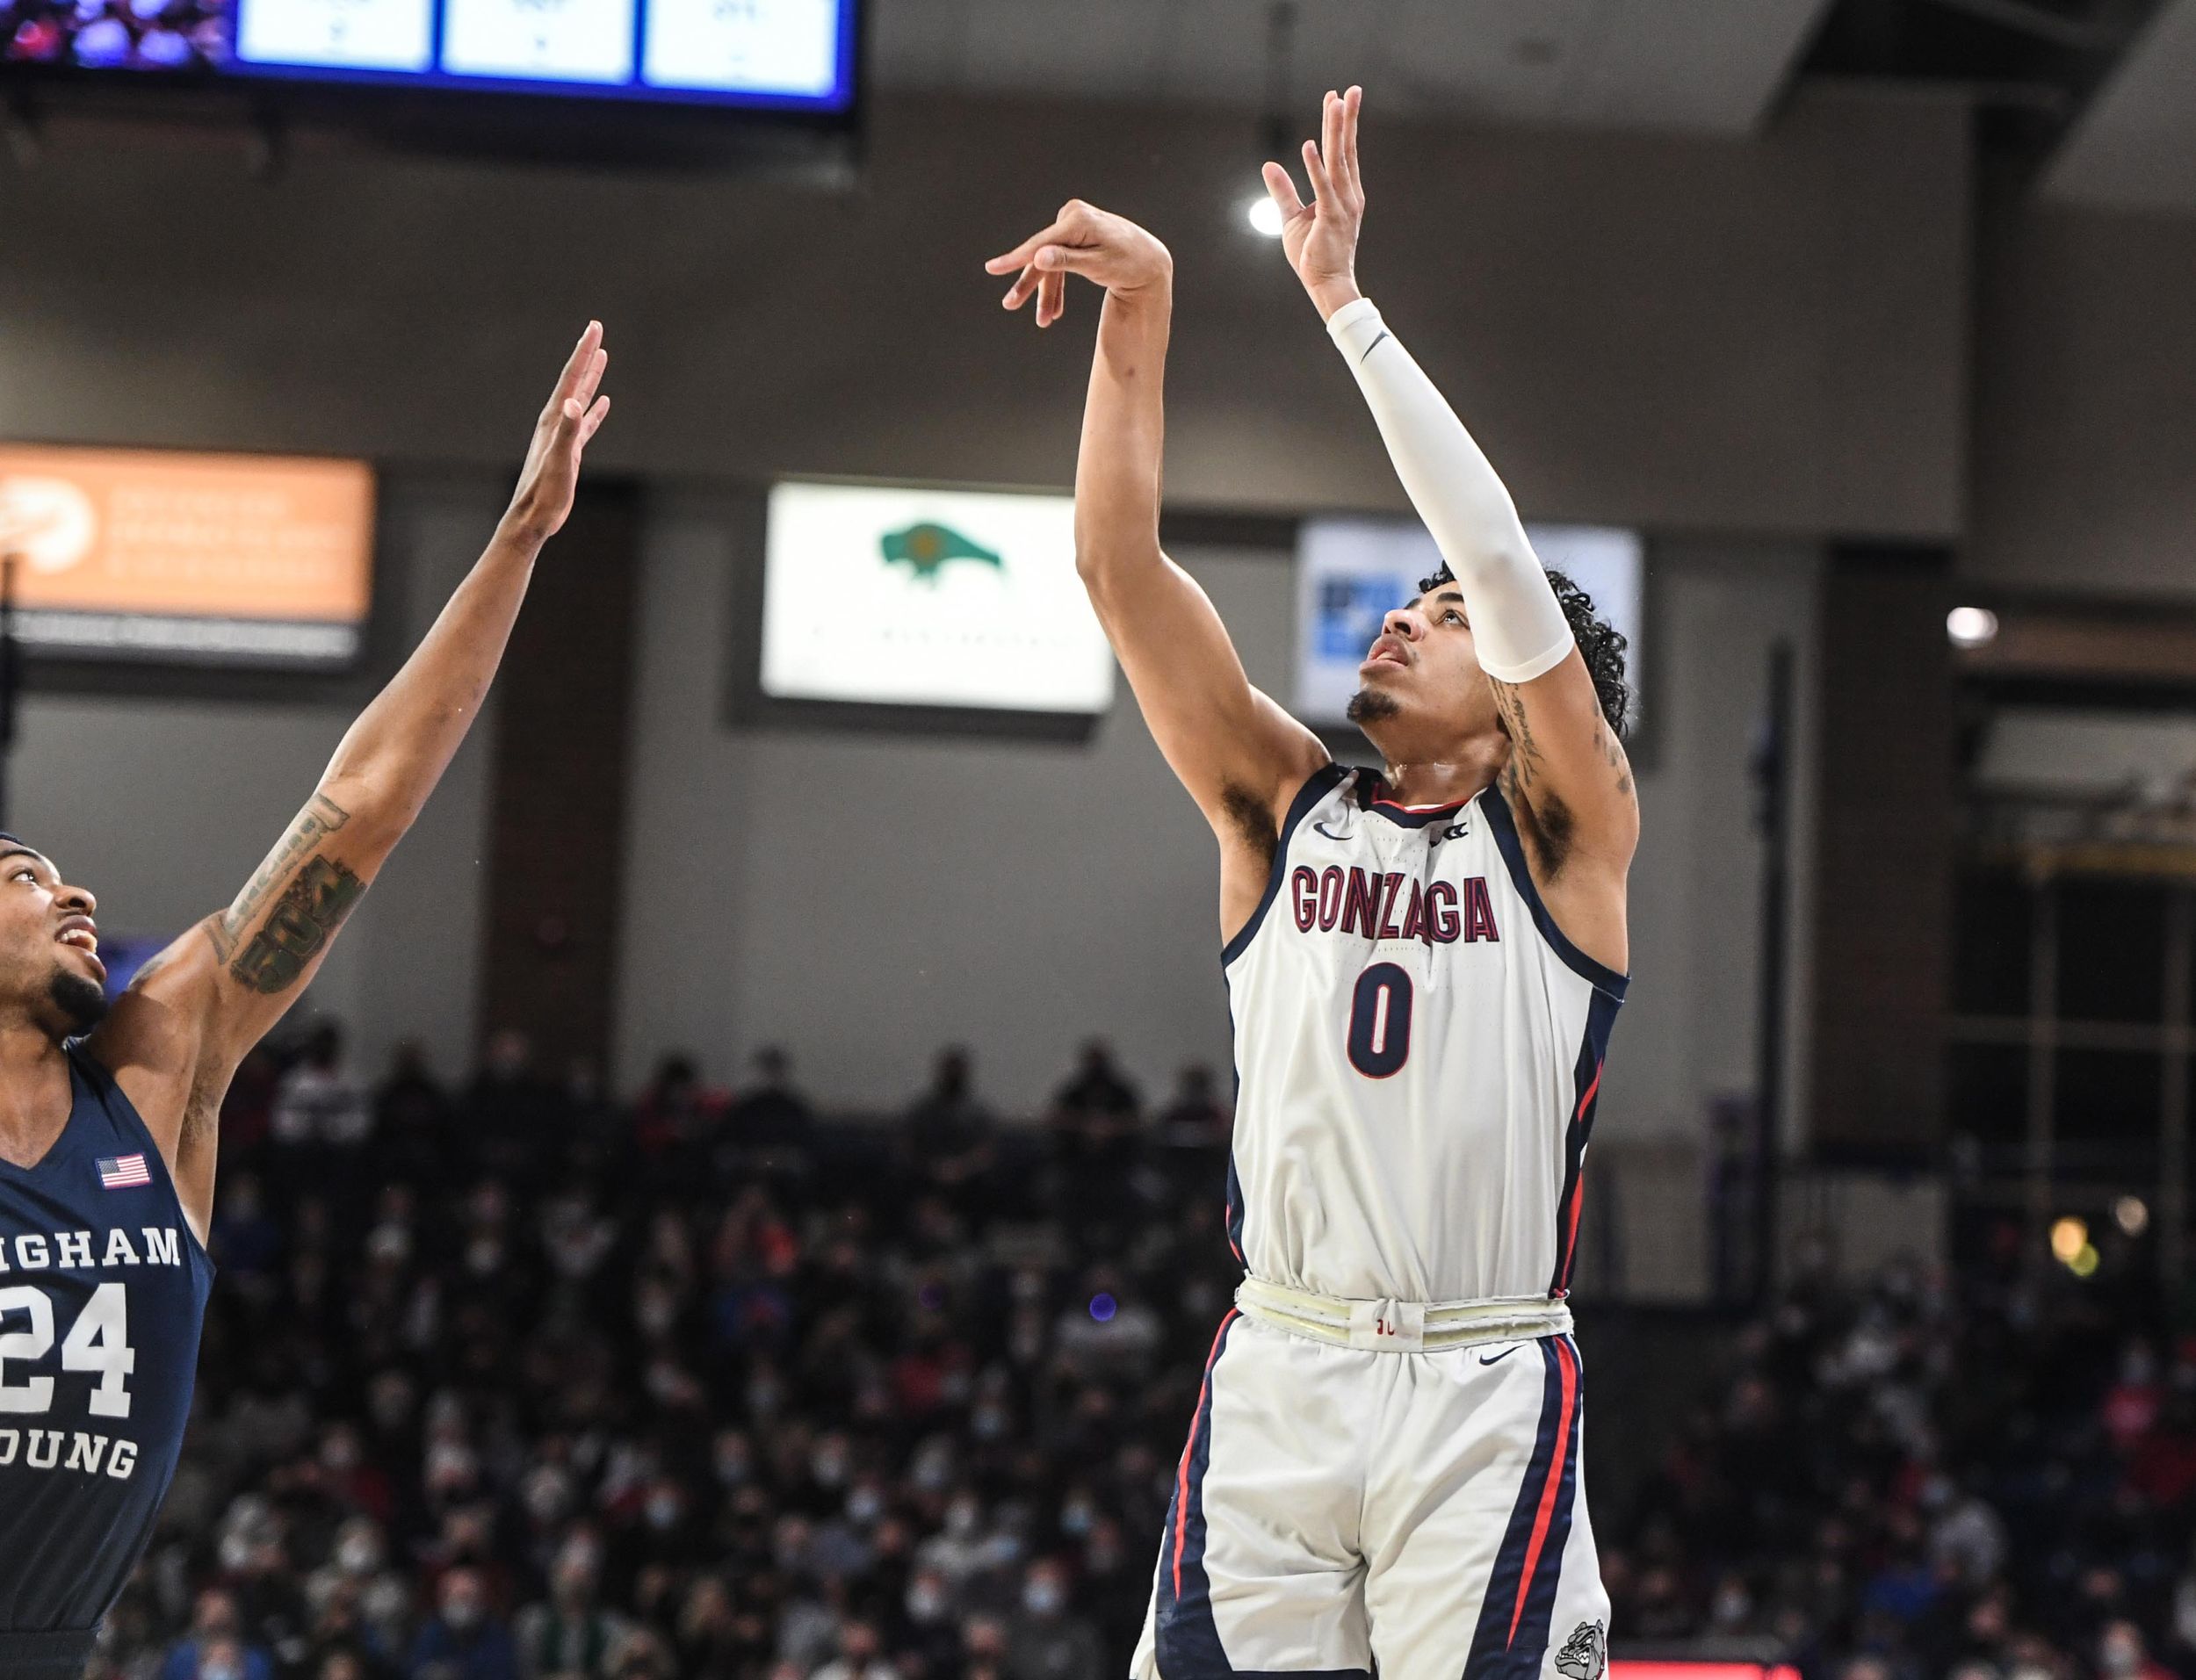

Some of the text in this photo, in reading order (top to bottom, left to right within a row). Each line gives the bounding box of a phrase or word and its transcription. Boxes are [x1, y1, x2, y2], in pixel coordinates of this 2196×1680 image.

[1291, 865, 1499, 947] GONZAGA
[1347, 962, 1413, 1079] 0
[0, 1283, 135, 1418] 24
